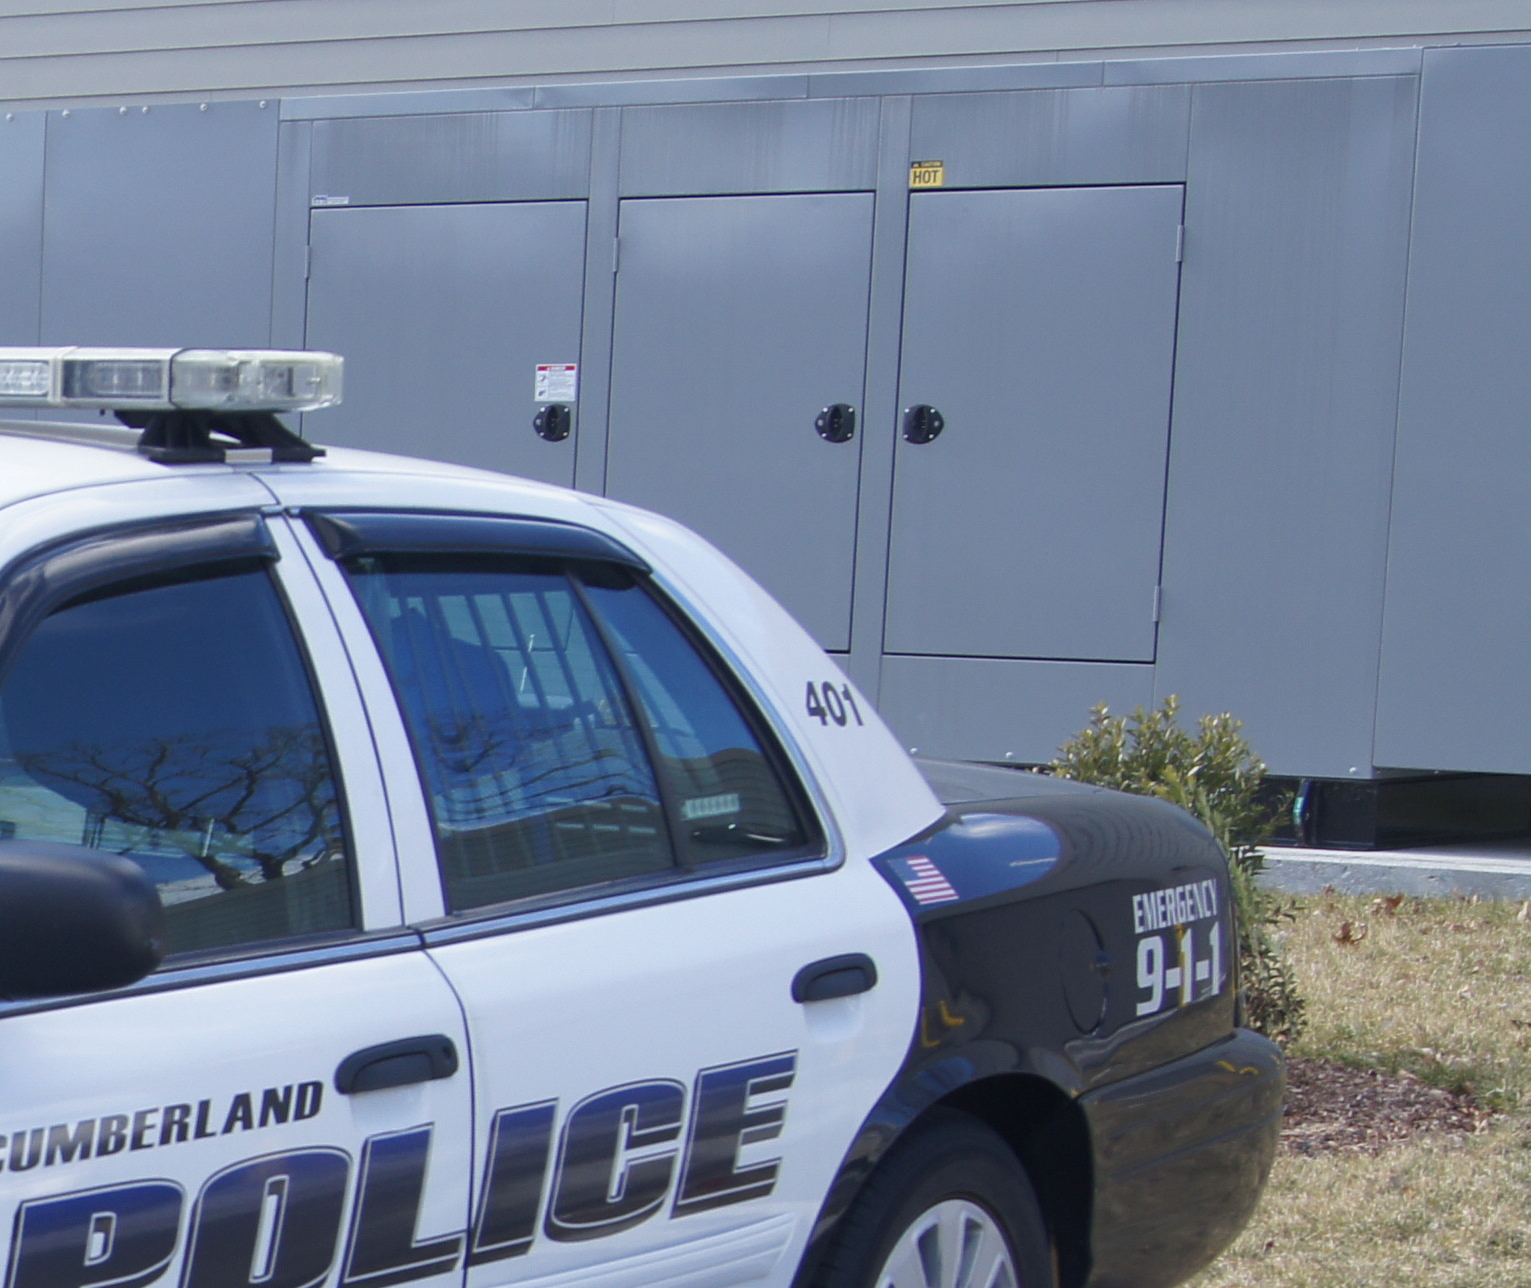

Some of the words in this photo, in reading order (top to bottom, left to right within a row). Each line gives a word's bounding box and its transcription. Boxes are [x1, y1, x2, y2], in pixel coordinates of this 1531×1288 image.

[913, 169, 940, 185] HOT
[806, 681, 864, 727] 401
[1132, 878, 1218, 934] EMERGENCY
[1136, 921, 1220, 1016] 9-1-1
